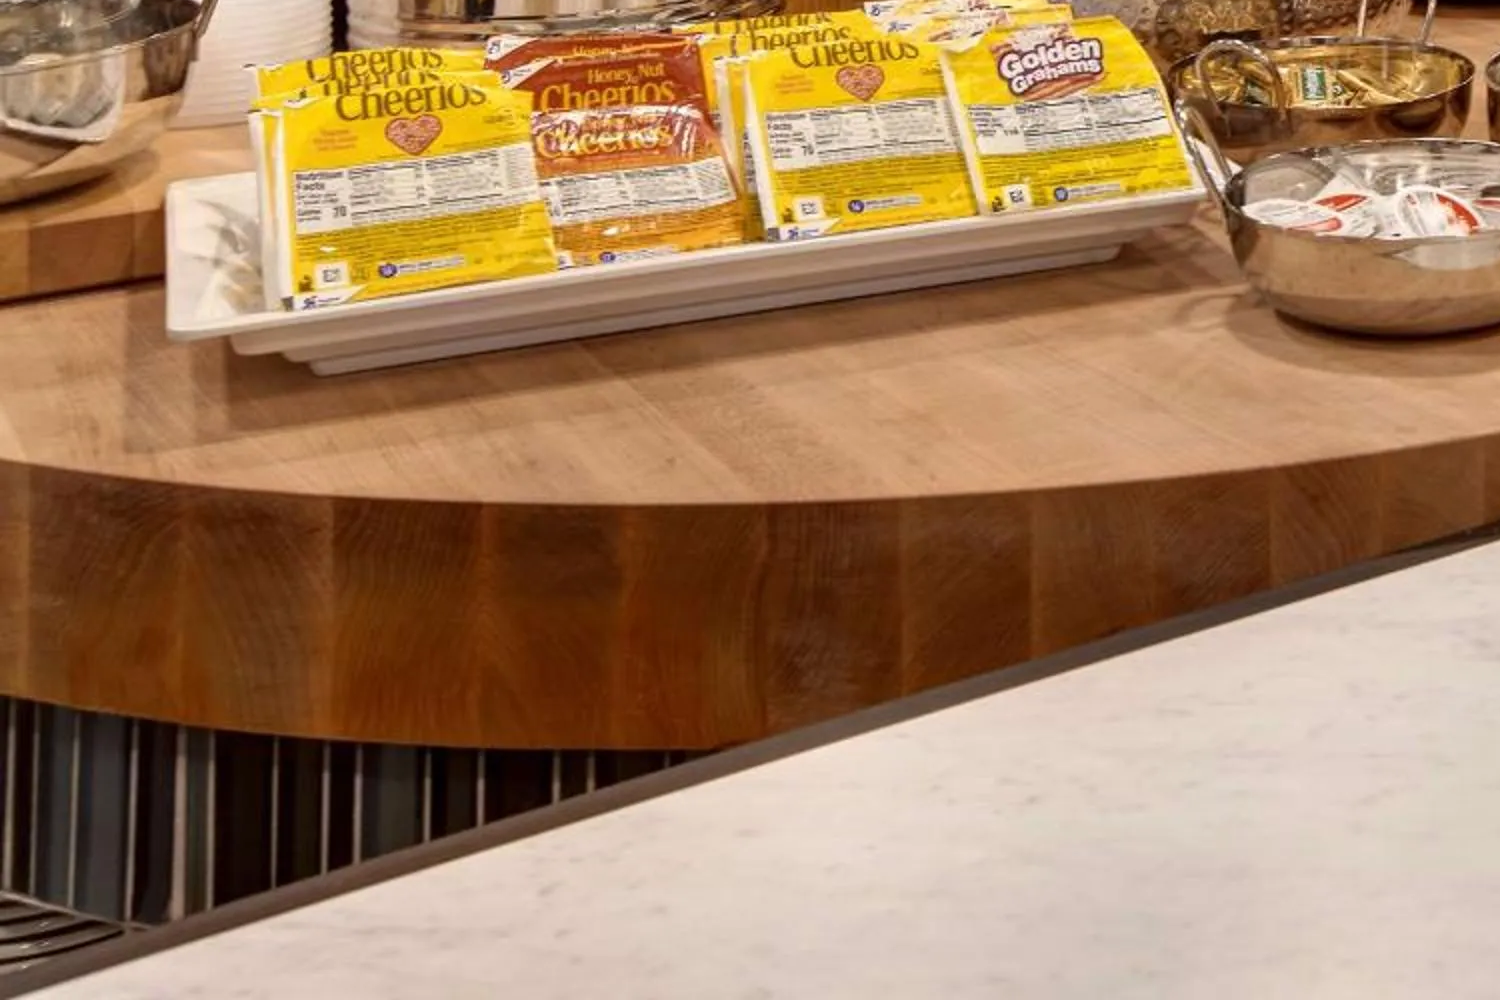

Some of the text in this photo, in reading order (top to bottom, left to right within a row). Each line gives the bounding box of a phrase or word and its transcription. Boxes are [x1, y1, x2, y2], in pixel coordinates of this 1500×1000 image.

[998, 36, 1102, 80] Golden
[1010, 57, 1103, 96] Grahams
[335, 82, 488, 122] Cheerios
[540, 80, 676, 114] Cheerios
